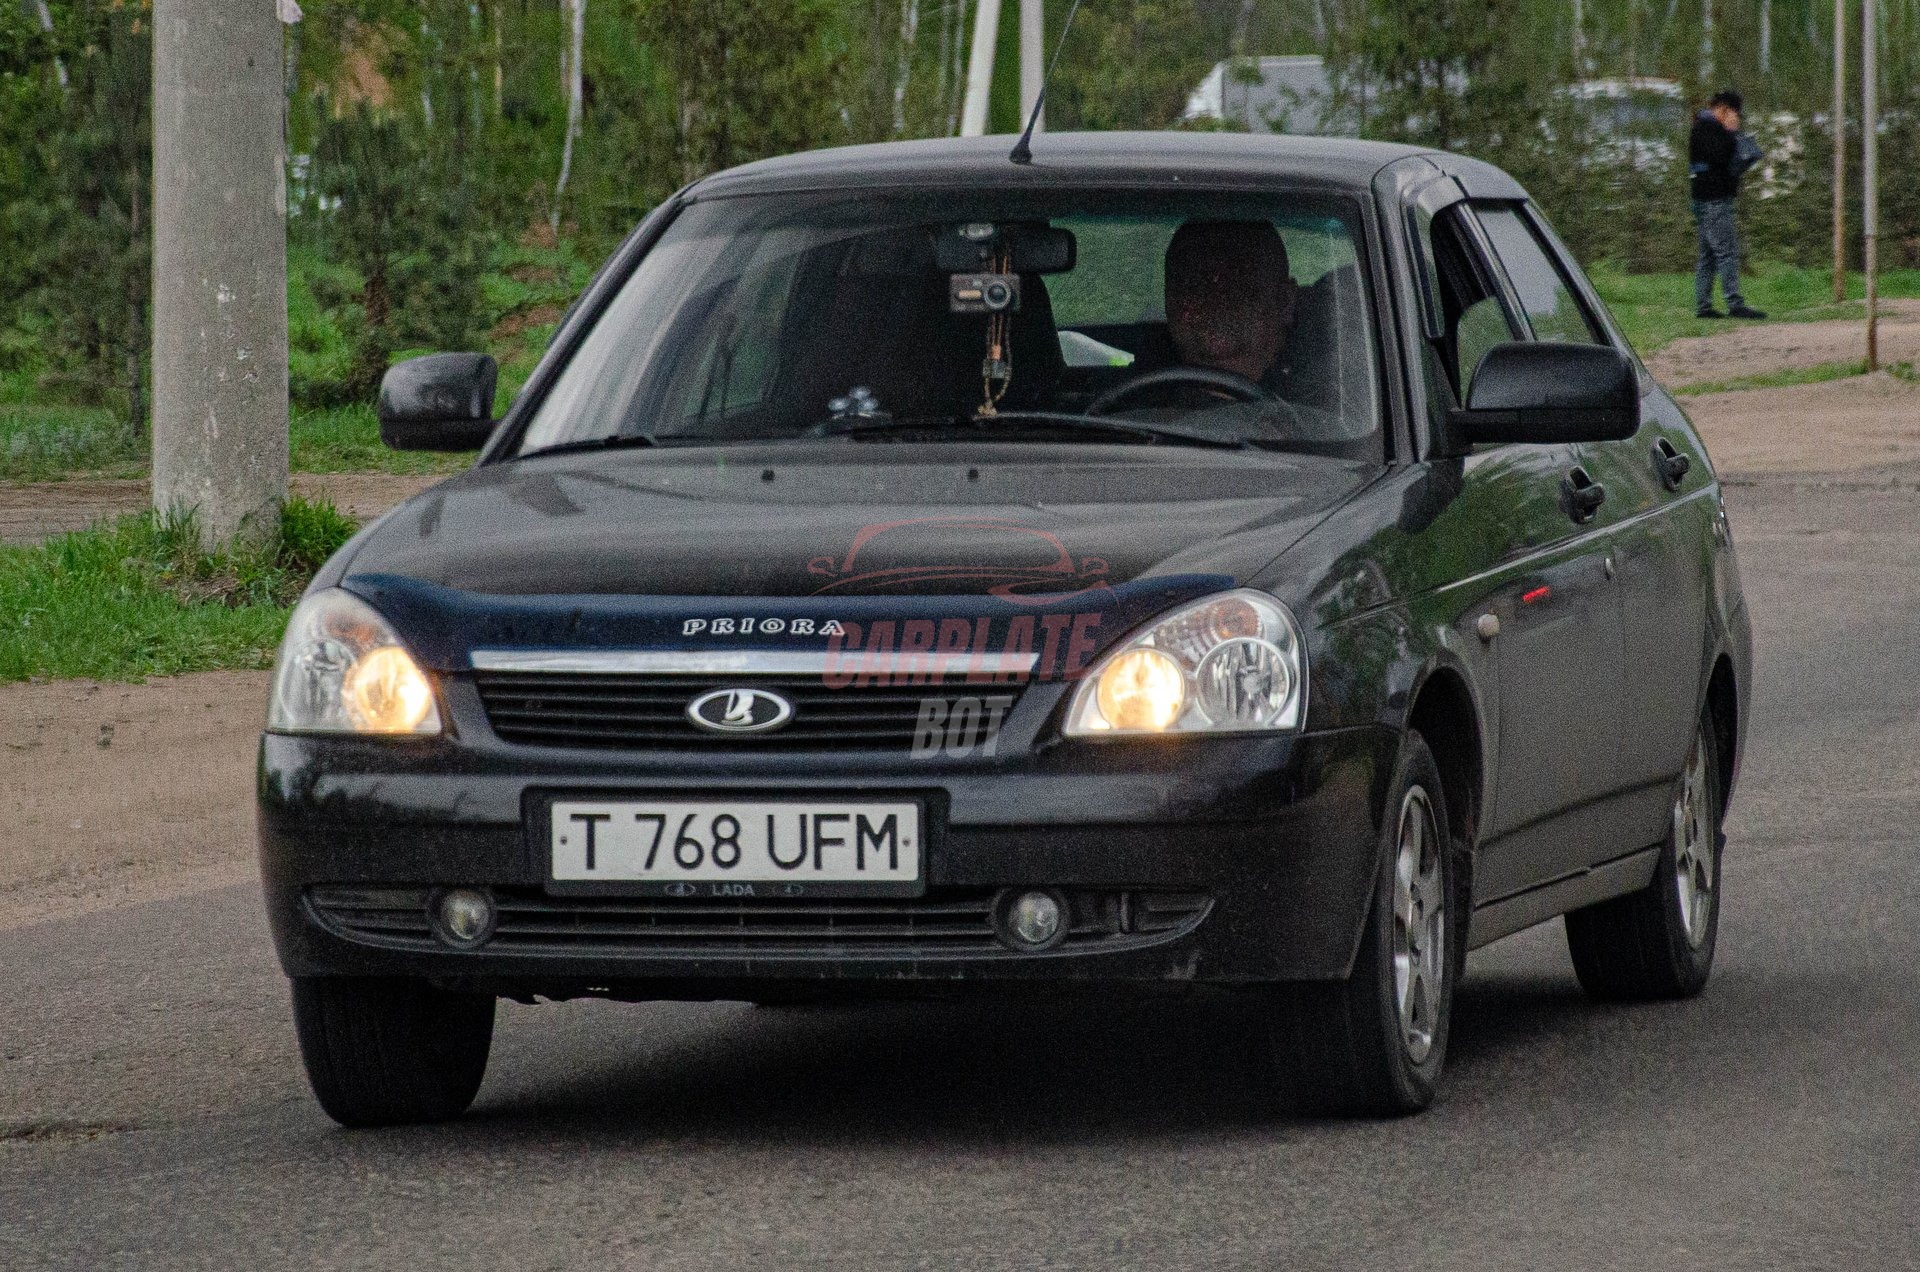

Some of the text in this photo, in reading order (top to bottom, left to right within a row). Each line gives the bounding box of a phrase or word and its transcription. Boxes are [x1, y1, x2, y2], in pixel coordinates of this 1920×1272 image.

[682, 617, 845, 636] PRIORA
[570, 813, 898, 870] T 768 UFM
[711, 884, 755, 897] LADA
